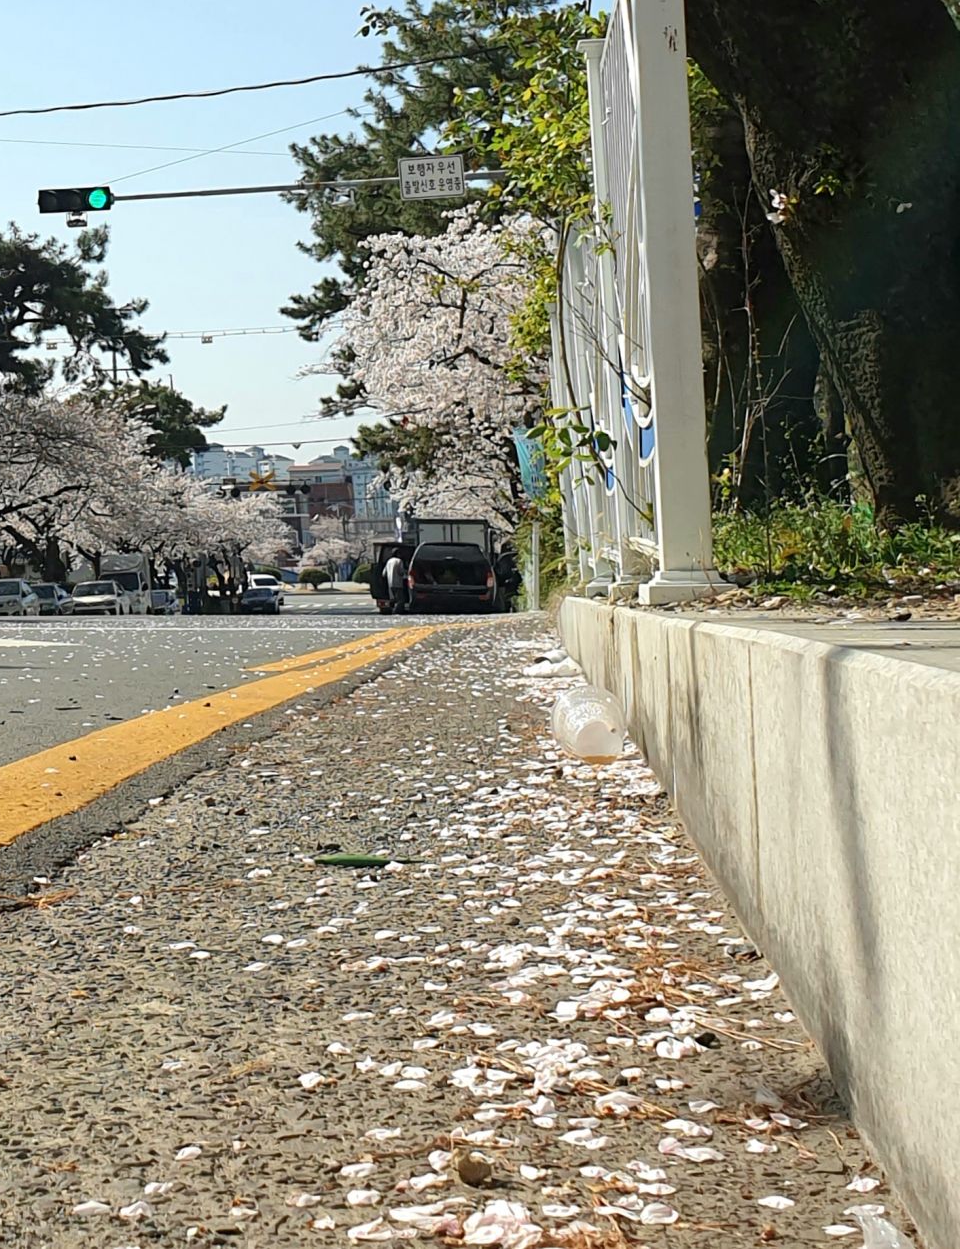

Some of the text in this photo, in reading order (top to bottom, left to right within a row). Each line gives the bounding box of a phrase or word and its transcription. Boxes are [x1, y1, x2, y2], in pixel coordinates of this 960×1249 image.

[408, 161, 456, 177] 보행자 우선
[404, 177, 461, 195] 출발신호 운영중
